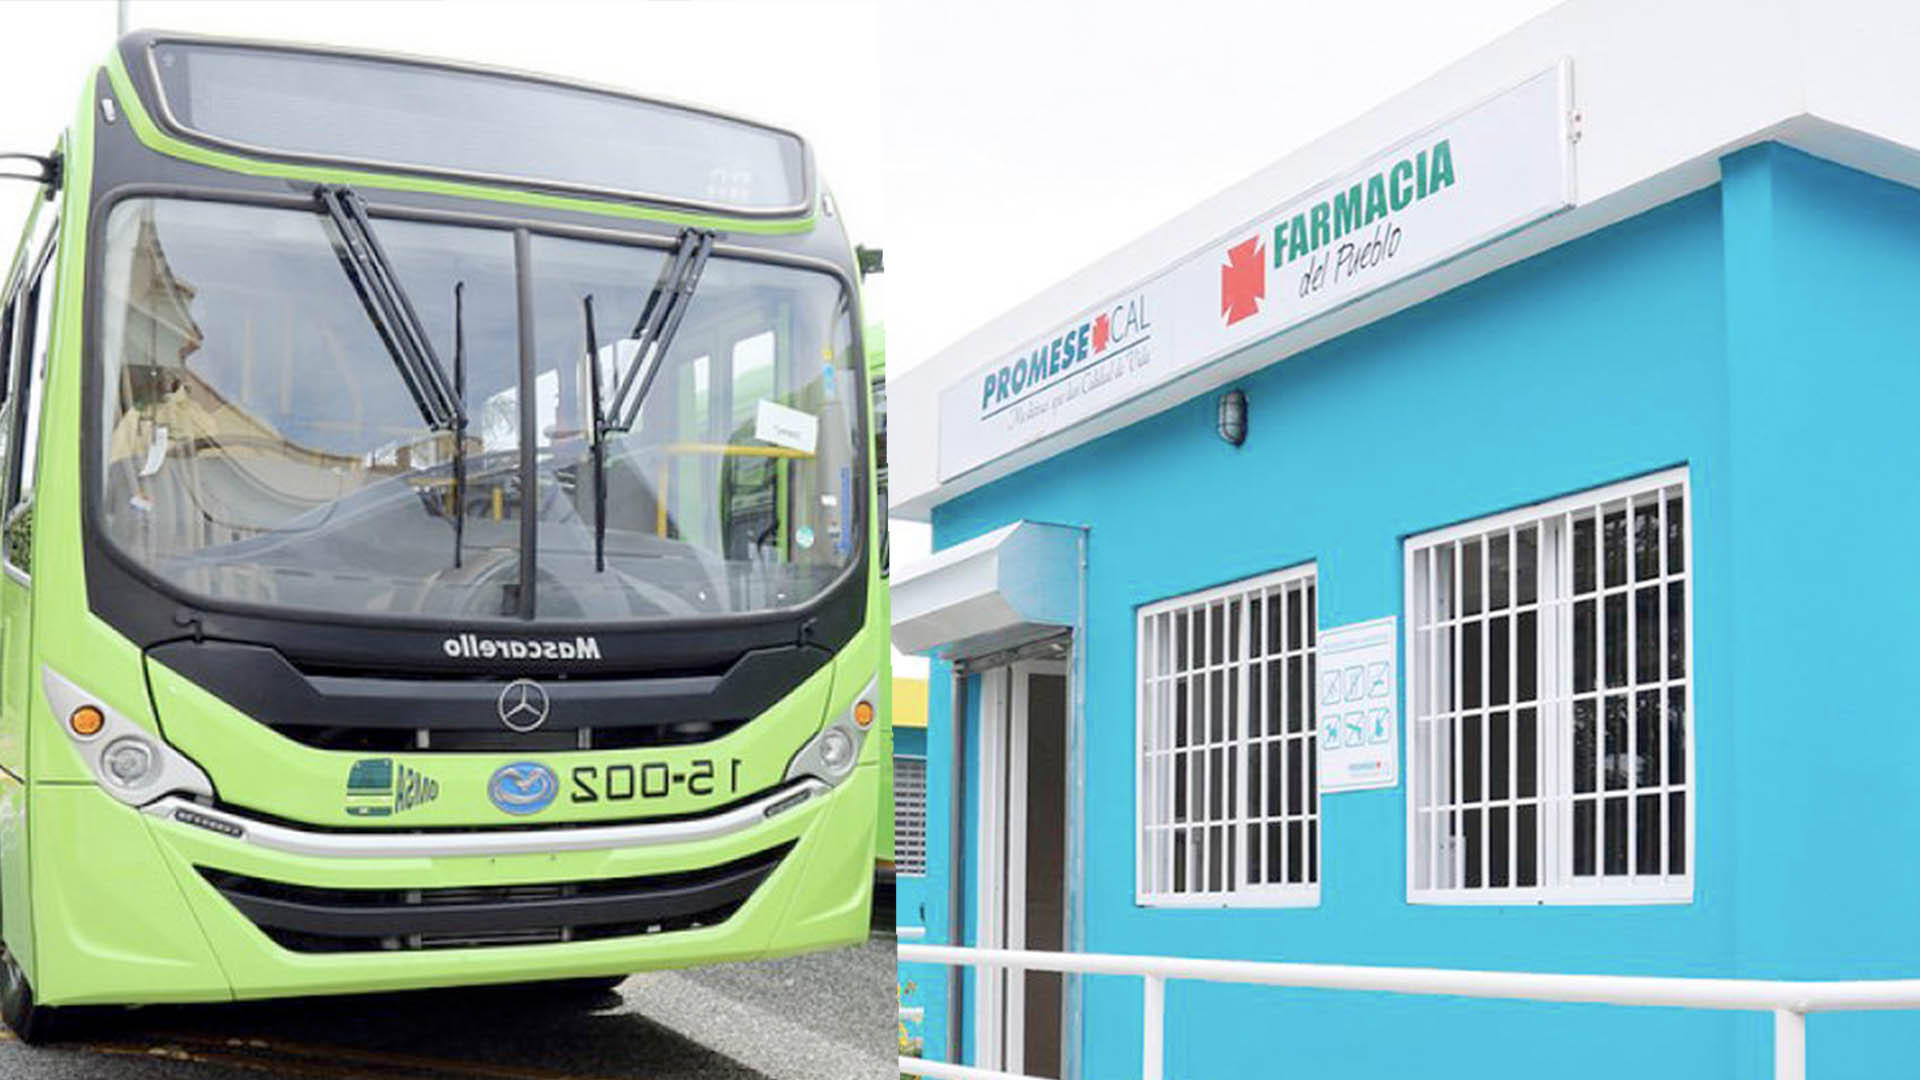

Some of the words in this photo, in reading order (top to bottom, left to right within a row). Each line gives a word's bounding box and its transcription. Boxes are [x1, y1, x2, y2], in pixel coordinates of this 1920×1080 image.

[1273, 138, 1456, 269] FARMACIA
[1298, 252, 1331, 299] del
[1333, 222, 1403, 284] Pueblo
[982, 323, 1091, 411] PROMESE
[1111, 294, 1151, 344] CAL
